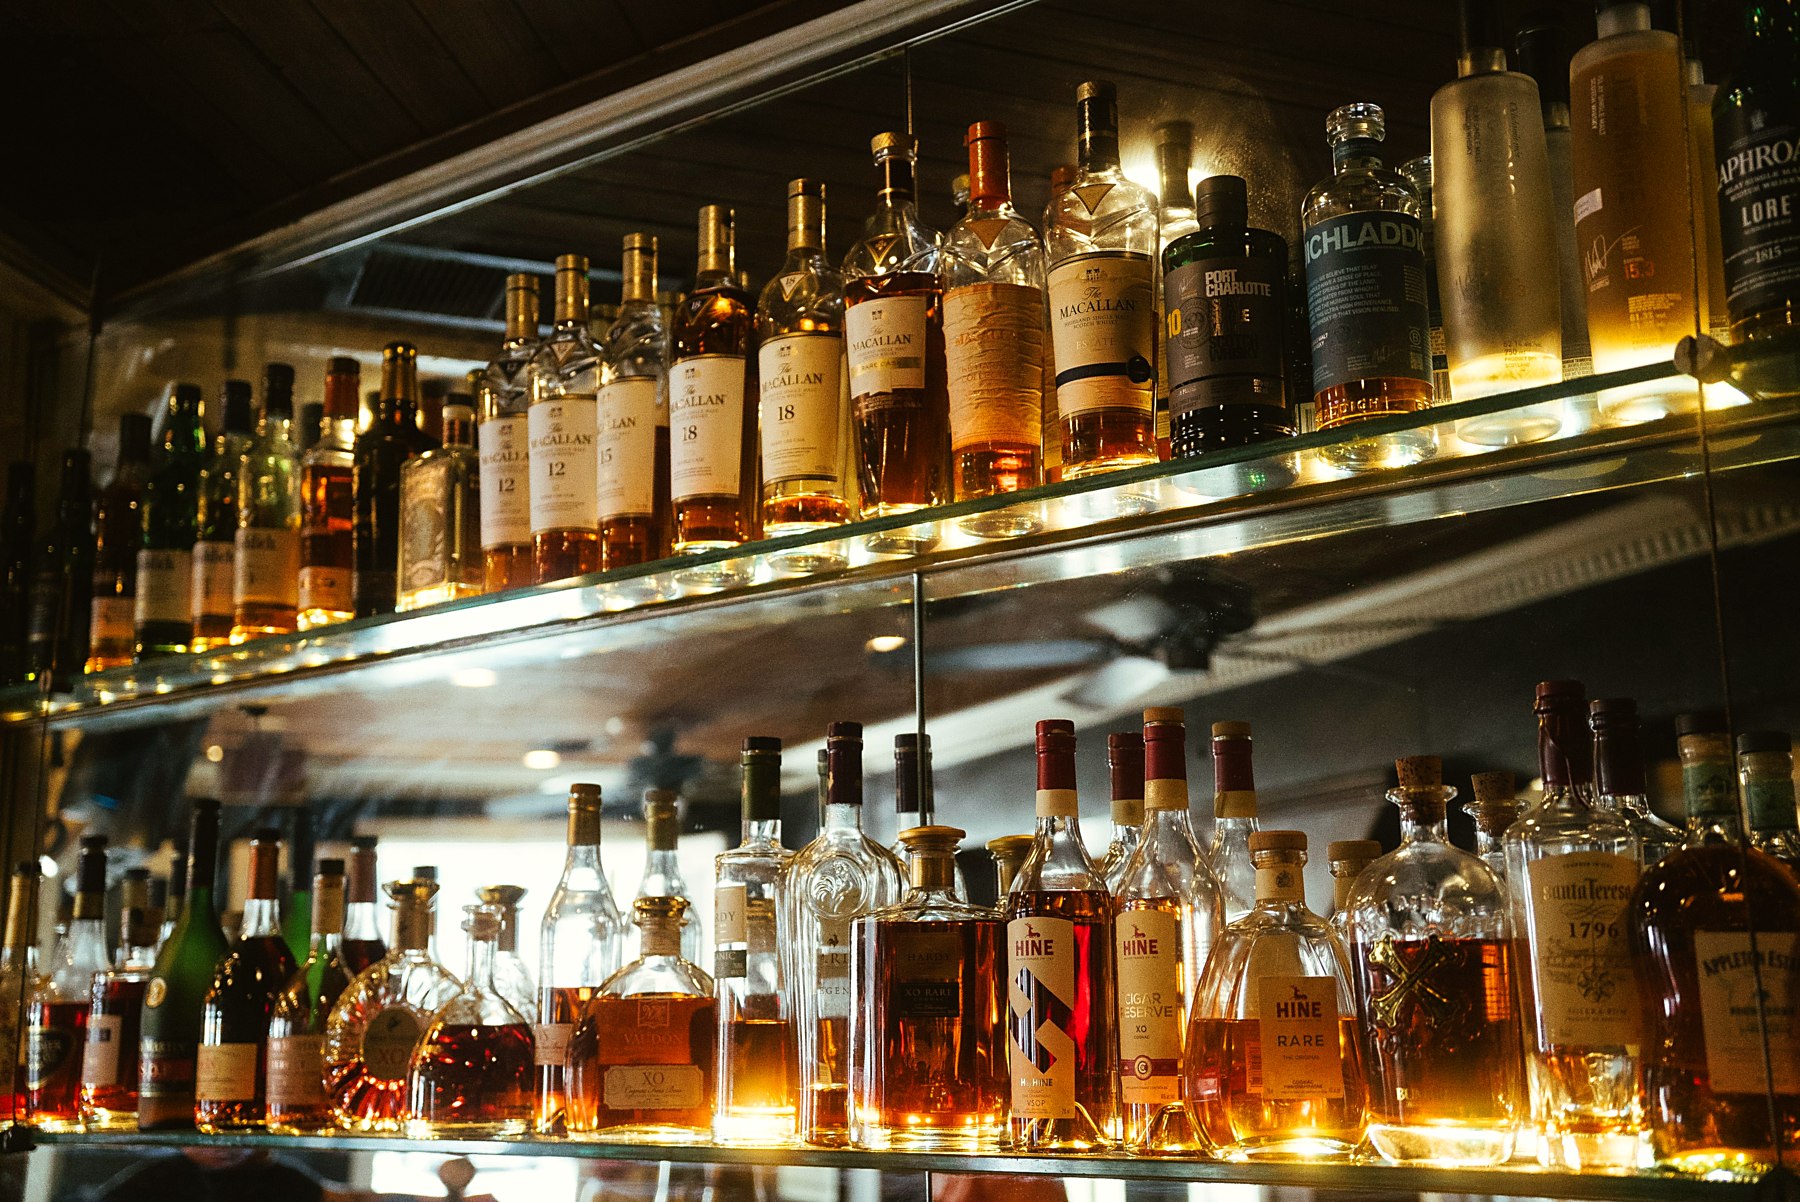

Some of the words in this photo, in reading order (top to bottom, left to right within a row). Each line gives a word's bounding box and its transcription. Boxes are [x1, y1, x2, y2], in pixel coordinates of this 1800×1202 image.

[1741, 194, 1791, 228] LORE
[1304, 221, 1425, 268] ICHLADDI
[1204, 269, 1238, 285] PORT
[1082, 286, 1103, 300] The
[1205, 281, 1272, 298] CHARLOTTE
[1059, 298, 1136, 321] MACALLAN
[1167, 308, 1182, 339] 10
[852, 333, 912, 351] MACALLAN
[762, 372, 824, 393] MACALLAN
[778, 404, 795, 421] 18
[682, 424, 698, 442] 18
[548, 461, 566, 477] 12
[498, 477, 516, 493] 12
[1568, 922, 1619, 939] 1796
[1015, 939, 1054, 957] HINE
[1123, 939, 1159, 957] HINE
[904, 988, 921, 997] XO
[1125, 992, 1162, 1006] CIGAR
[1276, 1001, 1323, 1018] HINE
[1135, 1025, 1147, 1033] XO
[1277, 1034, 1325, 1047] RARE
[641, 1071, 665, 1088] XO
[1032, 1078, 1054, 1087] HINE
